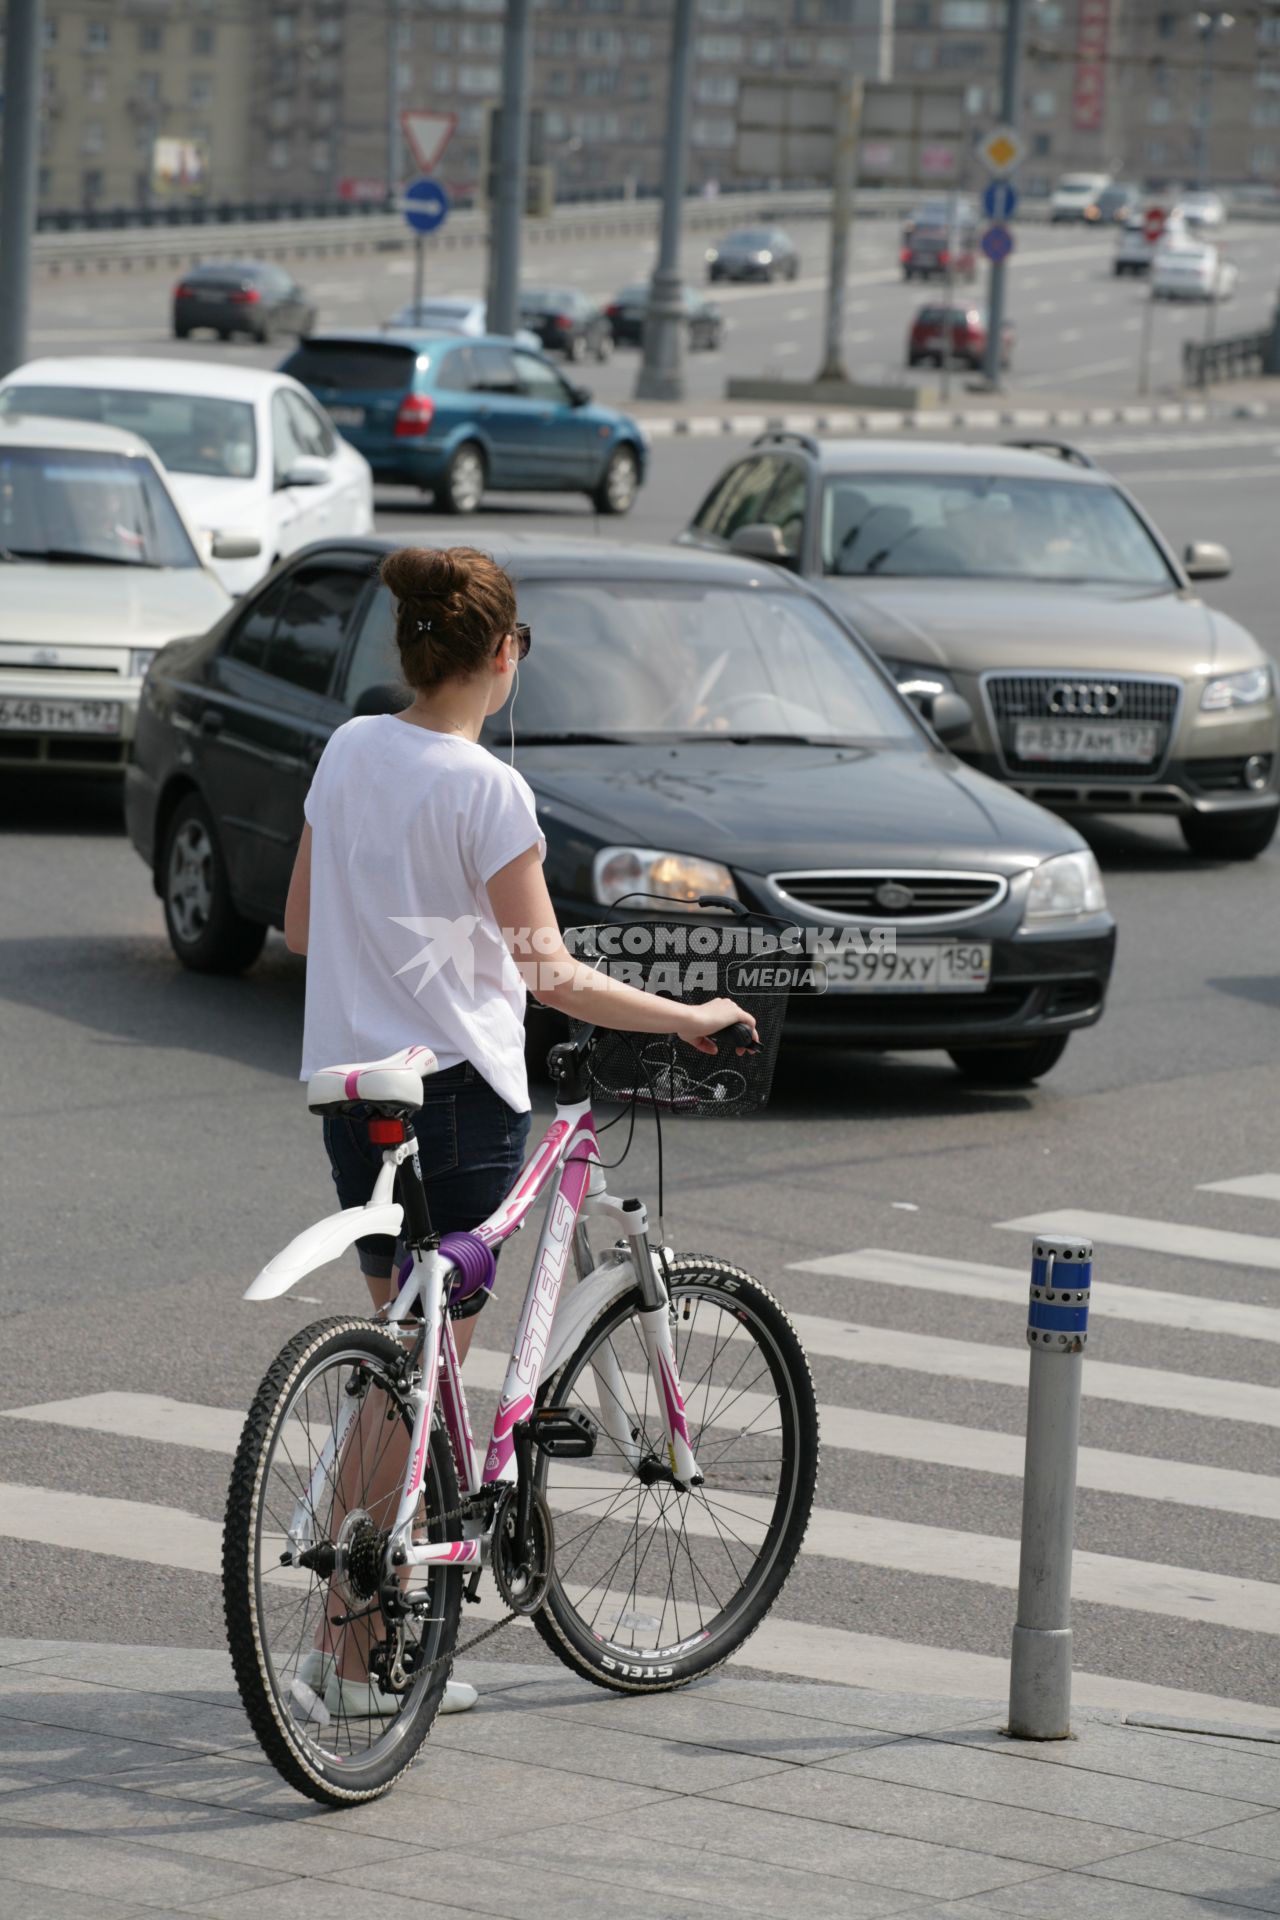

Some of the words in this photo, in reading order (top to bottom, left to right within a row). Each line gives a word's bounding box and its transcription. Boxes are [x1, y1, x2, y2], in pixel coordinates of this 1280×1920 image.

[943, 948, 983, 970] 150
[669, 1273, 741, 1292] STELS
[516, 1193, 576, 1396] STELS
[600, 1655, 676, 1678] STELS
